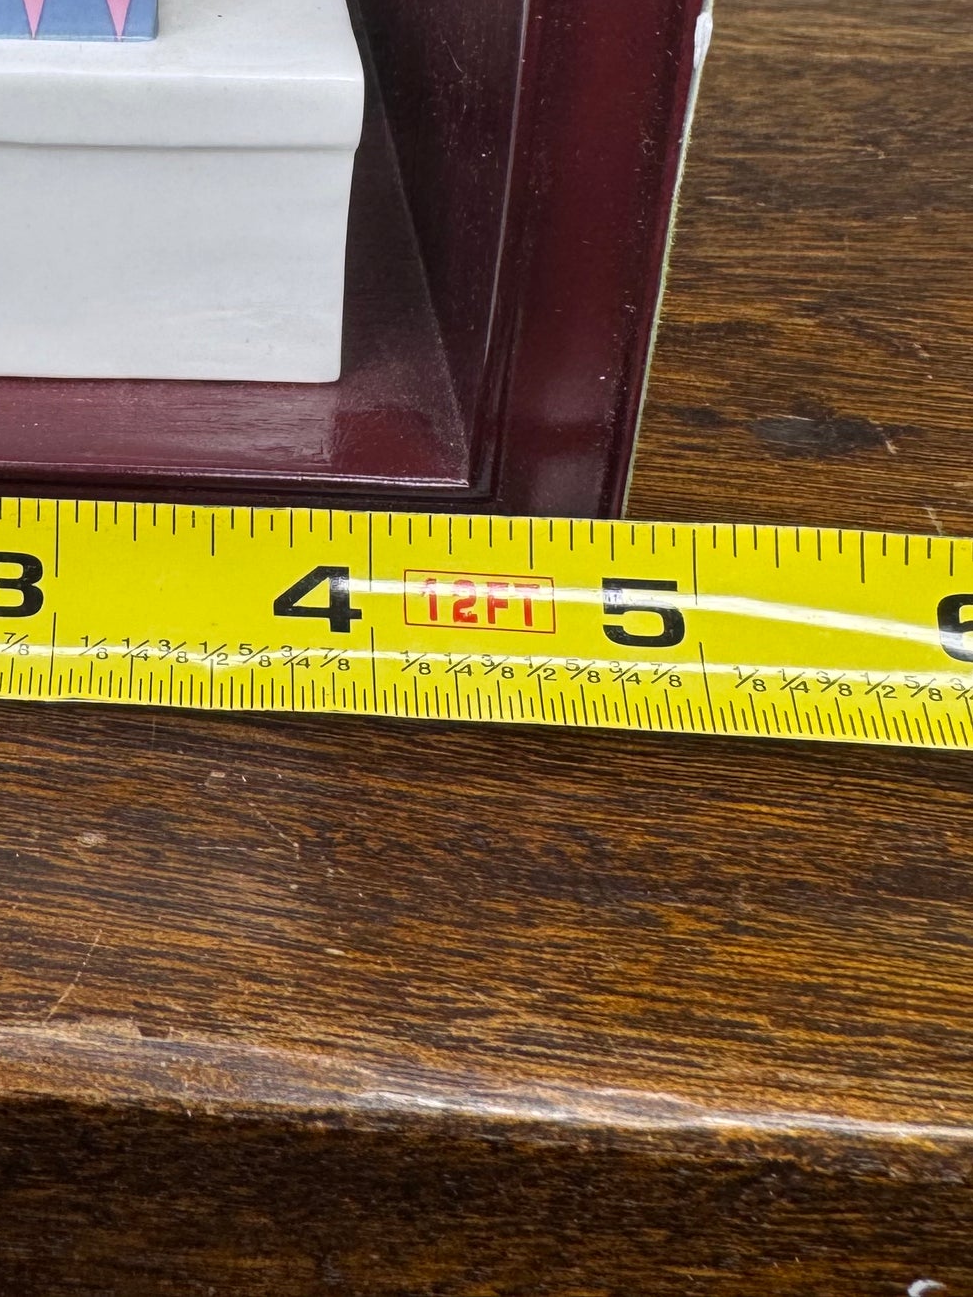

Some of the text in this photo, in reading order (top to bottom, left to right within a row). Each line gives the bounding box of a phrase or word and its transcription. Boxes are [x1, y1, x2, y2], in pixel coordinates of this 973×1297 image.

[273, 565, 363, 634] 4
[424, 577, 542, 628] 12FT
[601, 577, 686, 647] 5
